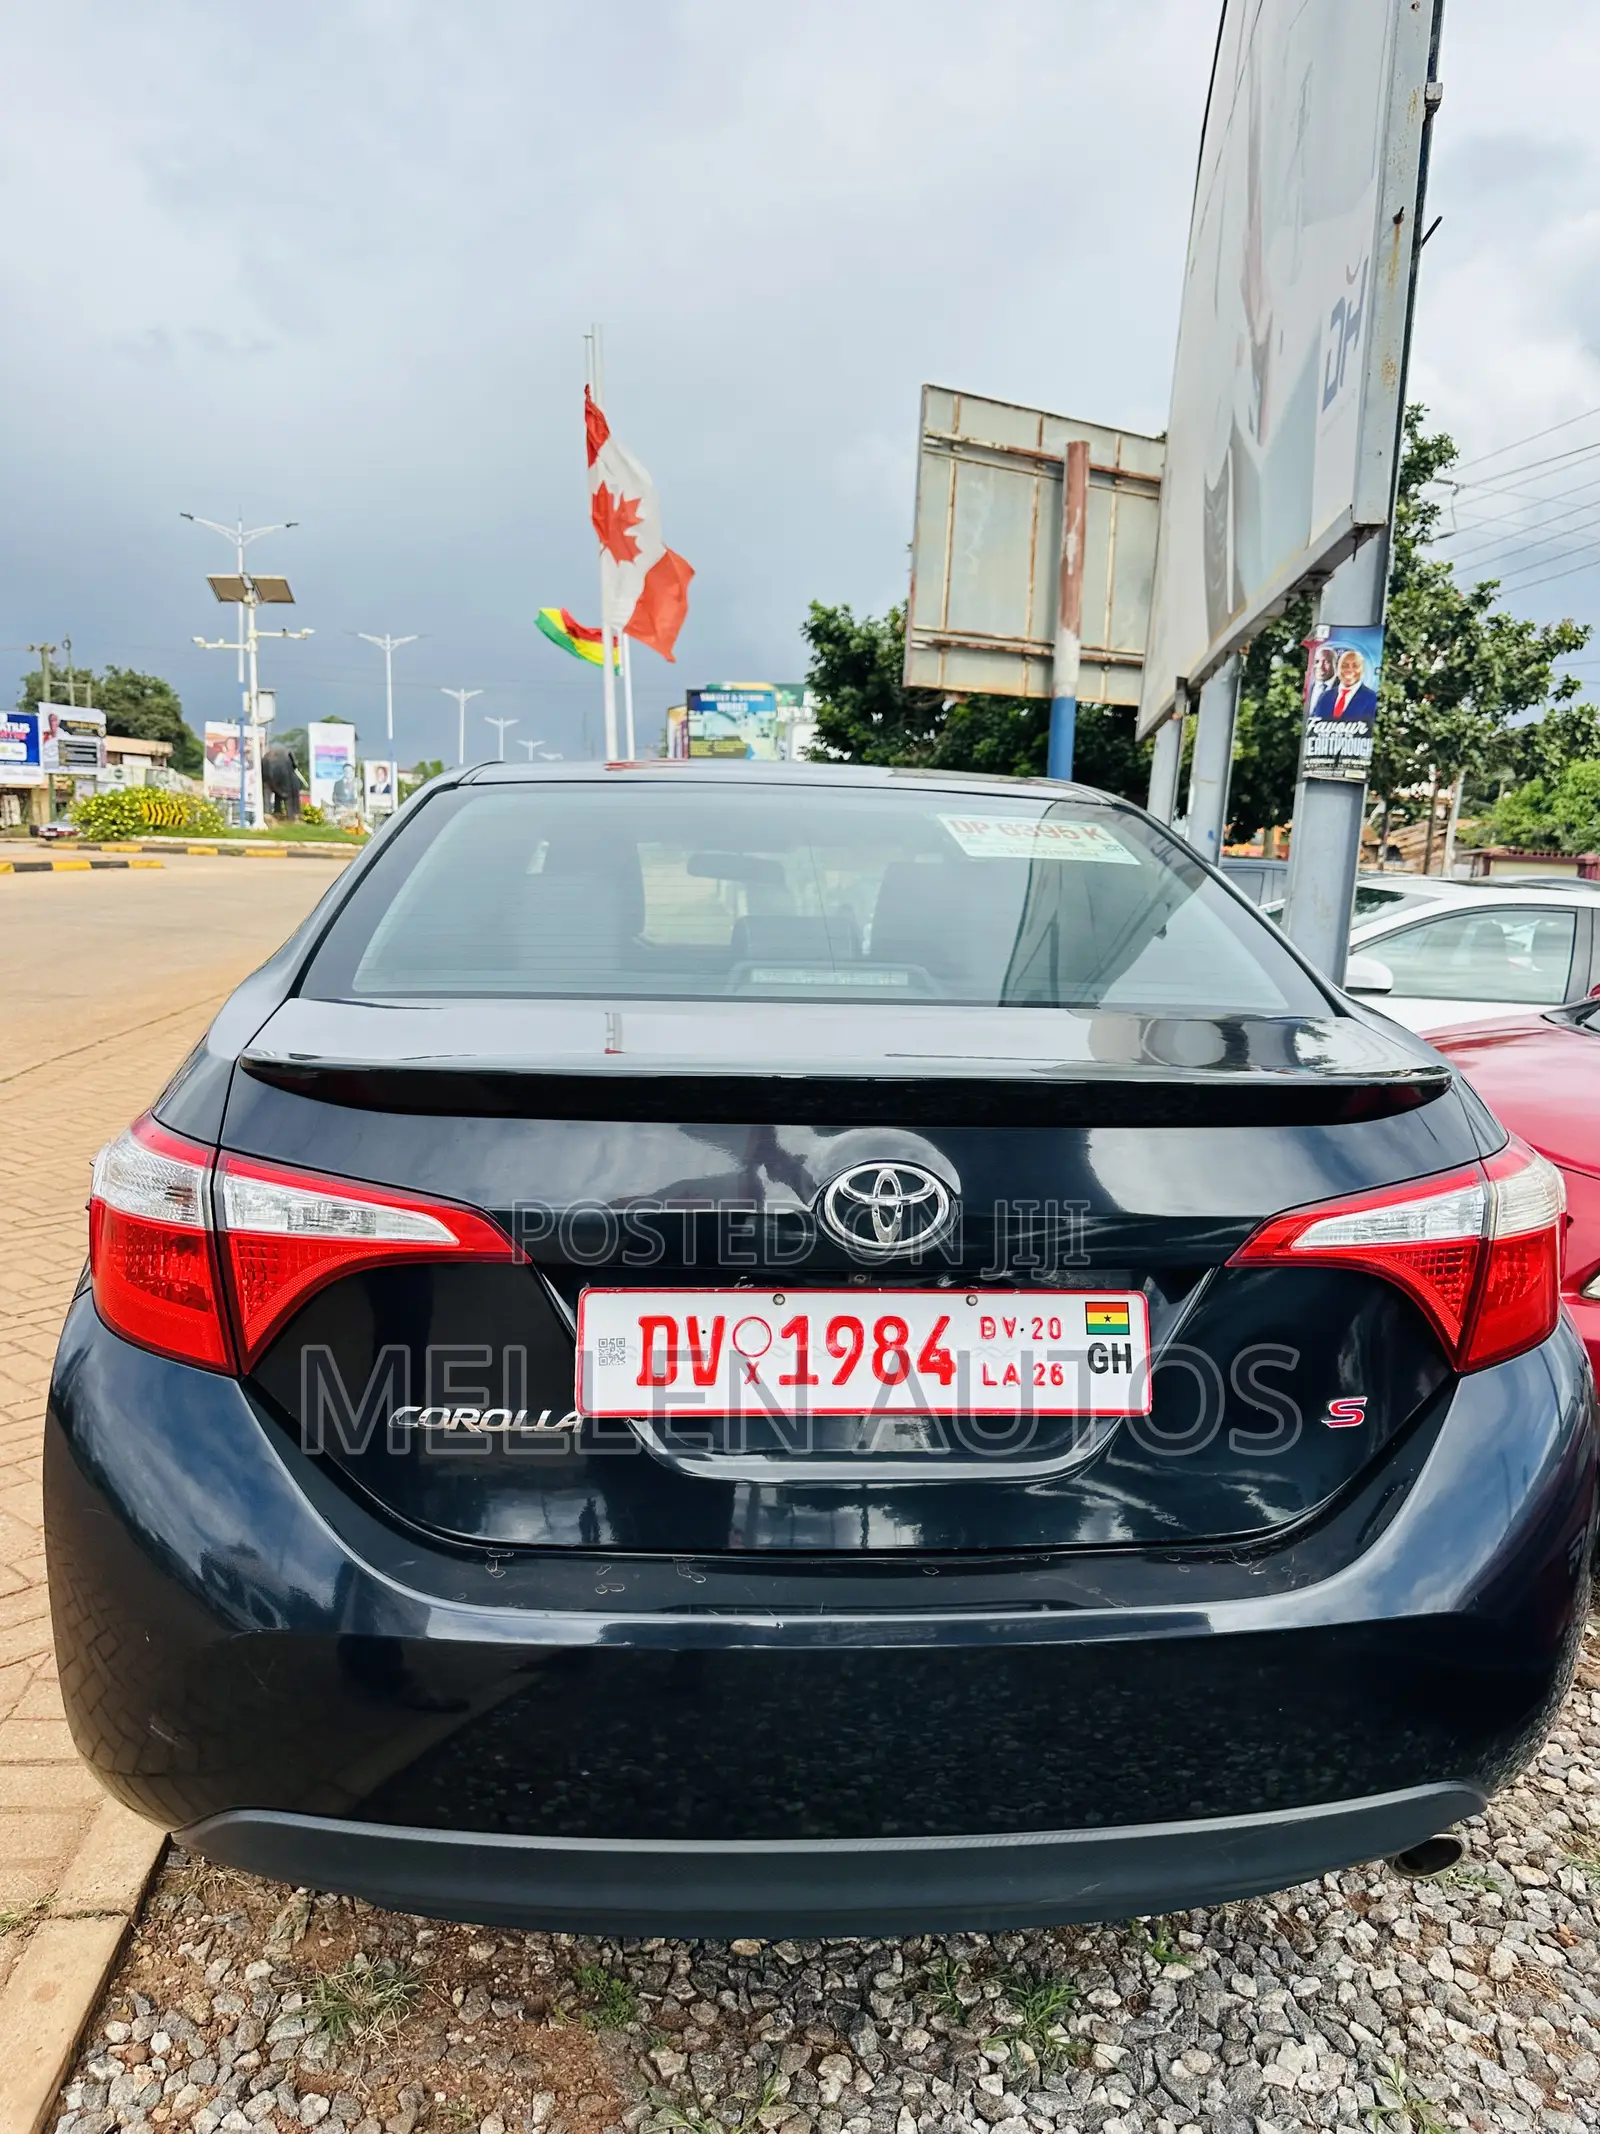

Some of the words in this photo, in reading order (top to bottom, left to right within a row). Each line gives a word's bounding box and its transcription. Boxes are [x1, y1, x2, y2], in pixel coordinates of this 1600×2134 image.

[1305, 717, 1369, 735] Favour
[996, 822, 1080, 840] 6395
[1031, 1316, 1062, 1340] 20
[636, 1315, 726, 1386] DV
[778, 1315, 957, 1386] 1984
[1087, 1342, 1133, 1374] GH
[982, 1363, 1021, 1386] LA
[1033, 1362, 1064, 1386] 26
[388, 1406, 584, 1433] COROLLA
[1320, 1396, 1368, 1428] S
